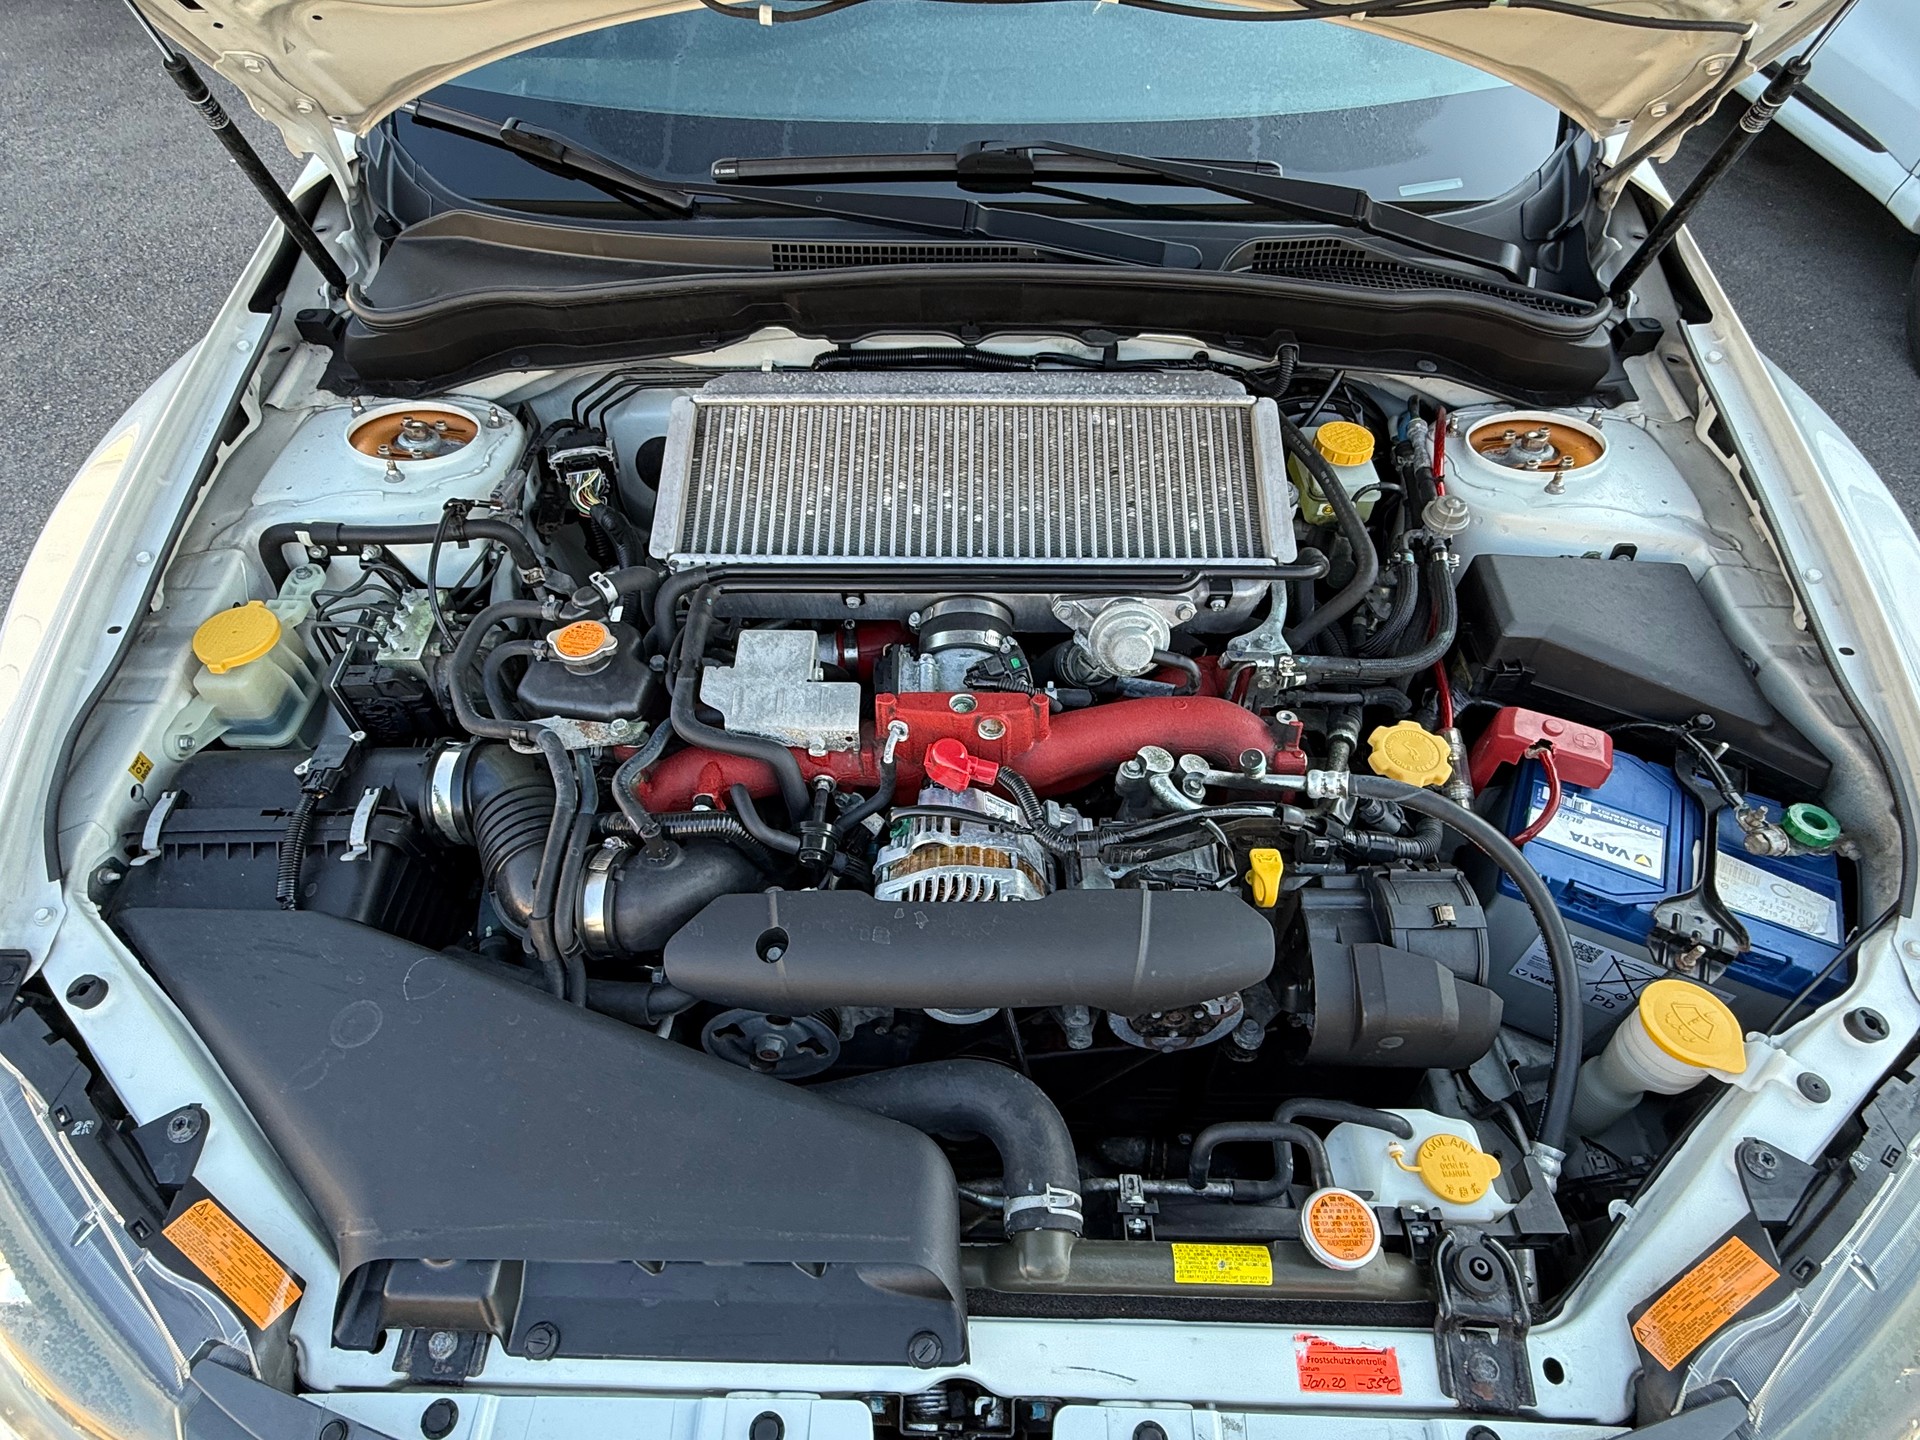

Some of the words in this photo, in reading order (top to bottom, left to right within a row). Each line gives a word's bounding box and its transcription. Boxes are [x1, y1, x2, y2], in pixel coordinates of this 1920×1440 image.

[1569, 830, 1631, 861] VARTA
[1530, 972, 1554, 986] VAR
[1590, 994, 1615, 1010] Pb
[1422, 1137, 1477, 1159] COOLANT
[1442, 1170, 1471, 1178] MANUAL
[1306, 1356, 1387, 1367] Frostschutzkontrolle
